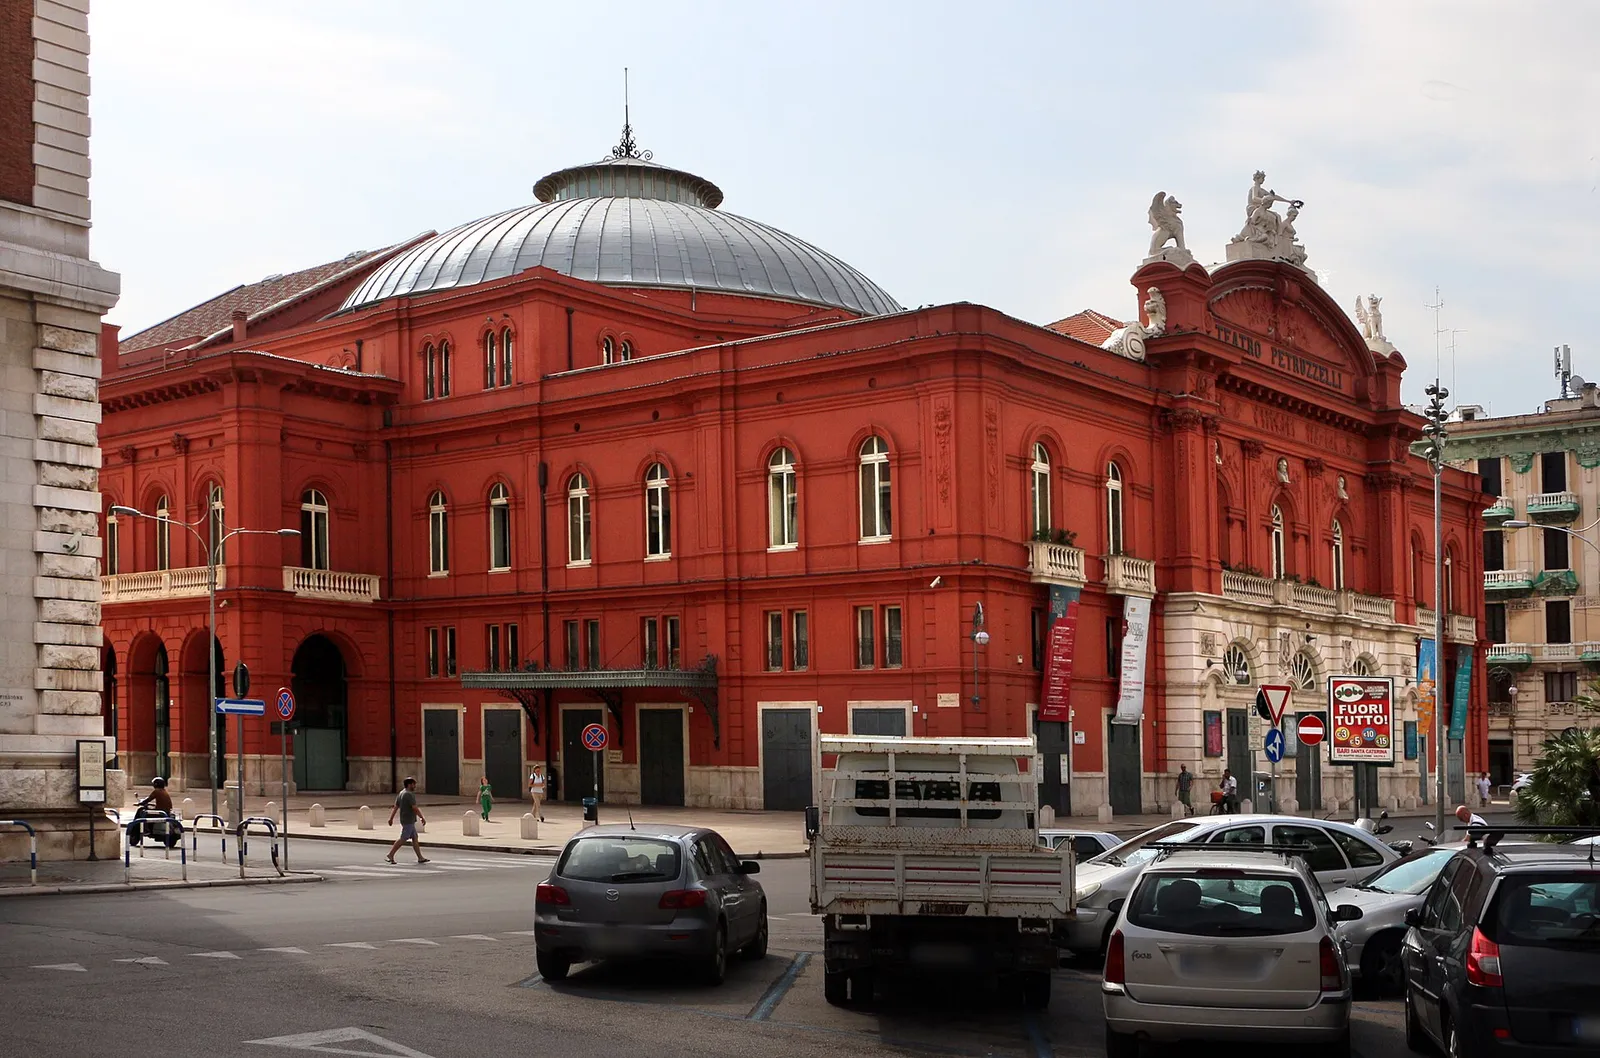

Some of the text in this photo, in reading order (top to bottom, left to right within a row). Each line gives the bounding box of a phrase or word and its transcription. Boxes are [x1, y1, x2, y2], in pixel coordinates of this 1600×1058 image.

[1215, 324, 1343, 390] TEATRO PETRUZZELLI
[1339, 704, 1383, 715] FUORI
[1335, 715, 1388, 726] TUTTO!
[1259, 781, 1265, 790] P
